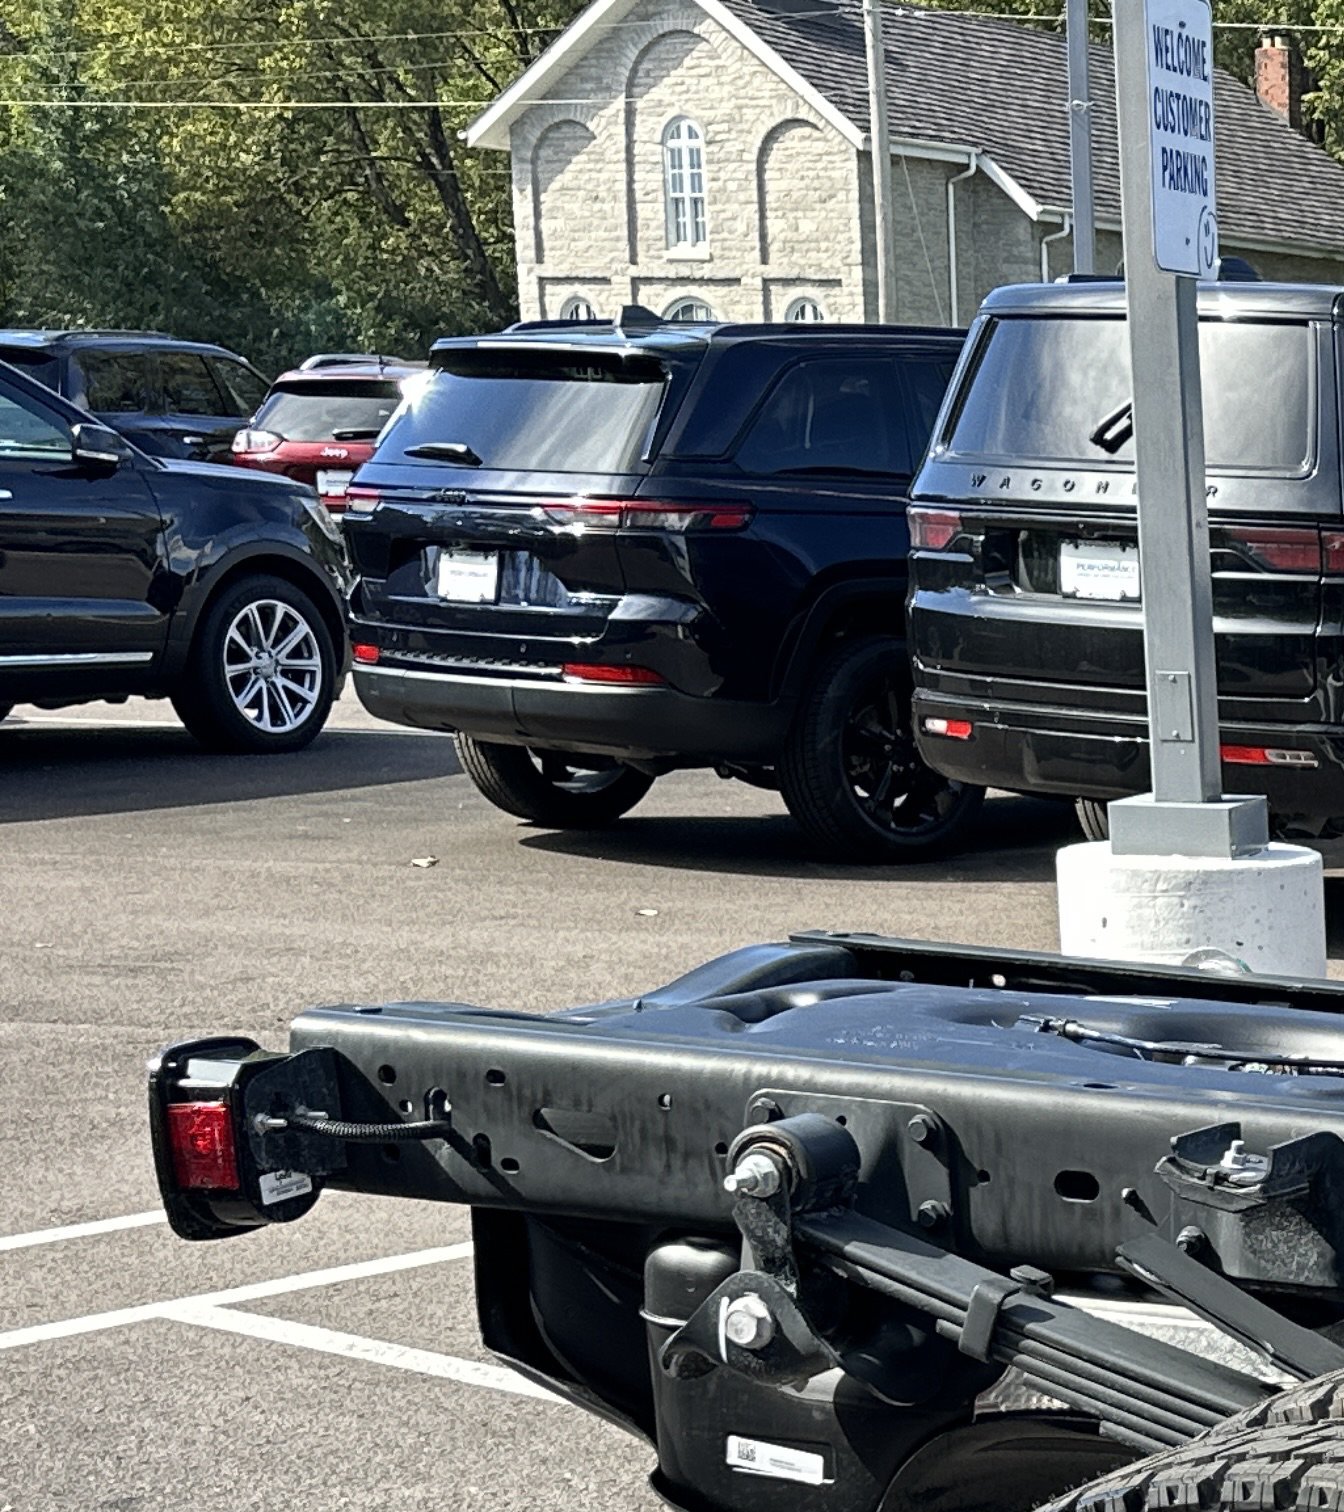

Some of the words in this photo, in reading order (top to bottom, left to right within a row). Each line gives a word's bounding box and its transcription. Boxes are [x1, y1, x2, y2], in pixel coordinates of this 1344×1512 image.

[1152, 24, 1209, 83] WELCOME
[1153, 86, 1211, 142] CUSTOMER
[1161, 146, 1208, 198] PARKING
[320, 447, 348, 459] Jeep
[971, 474, 1218, 498] WAGONR
